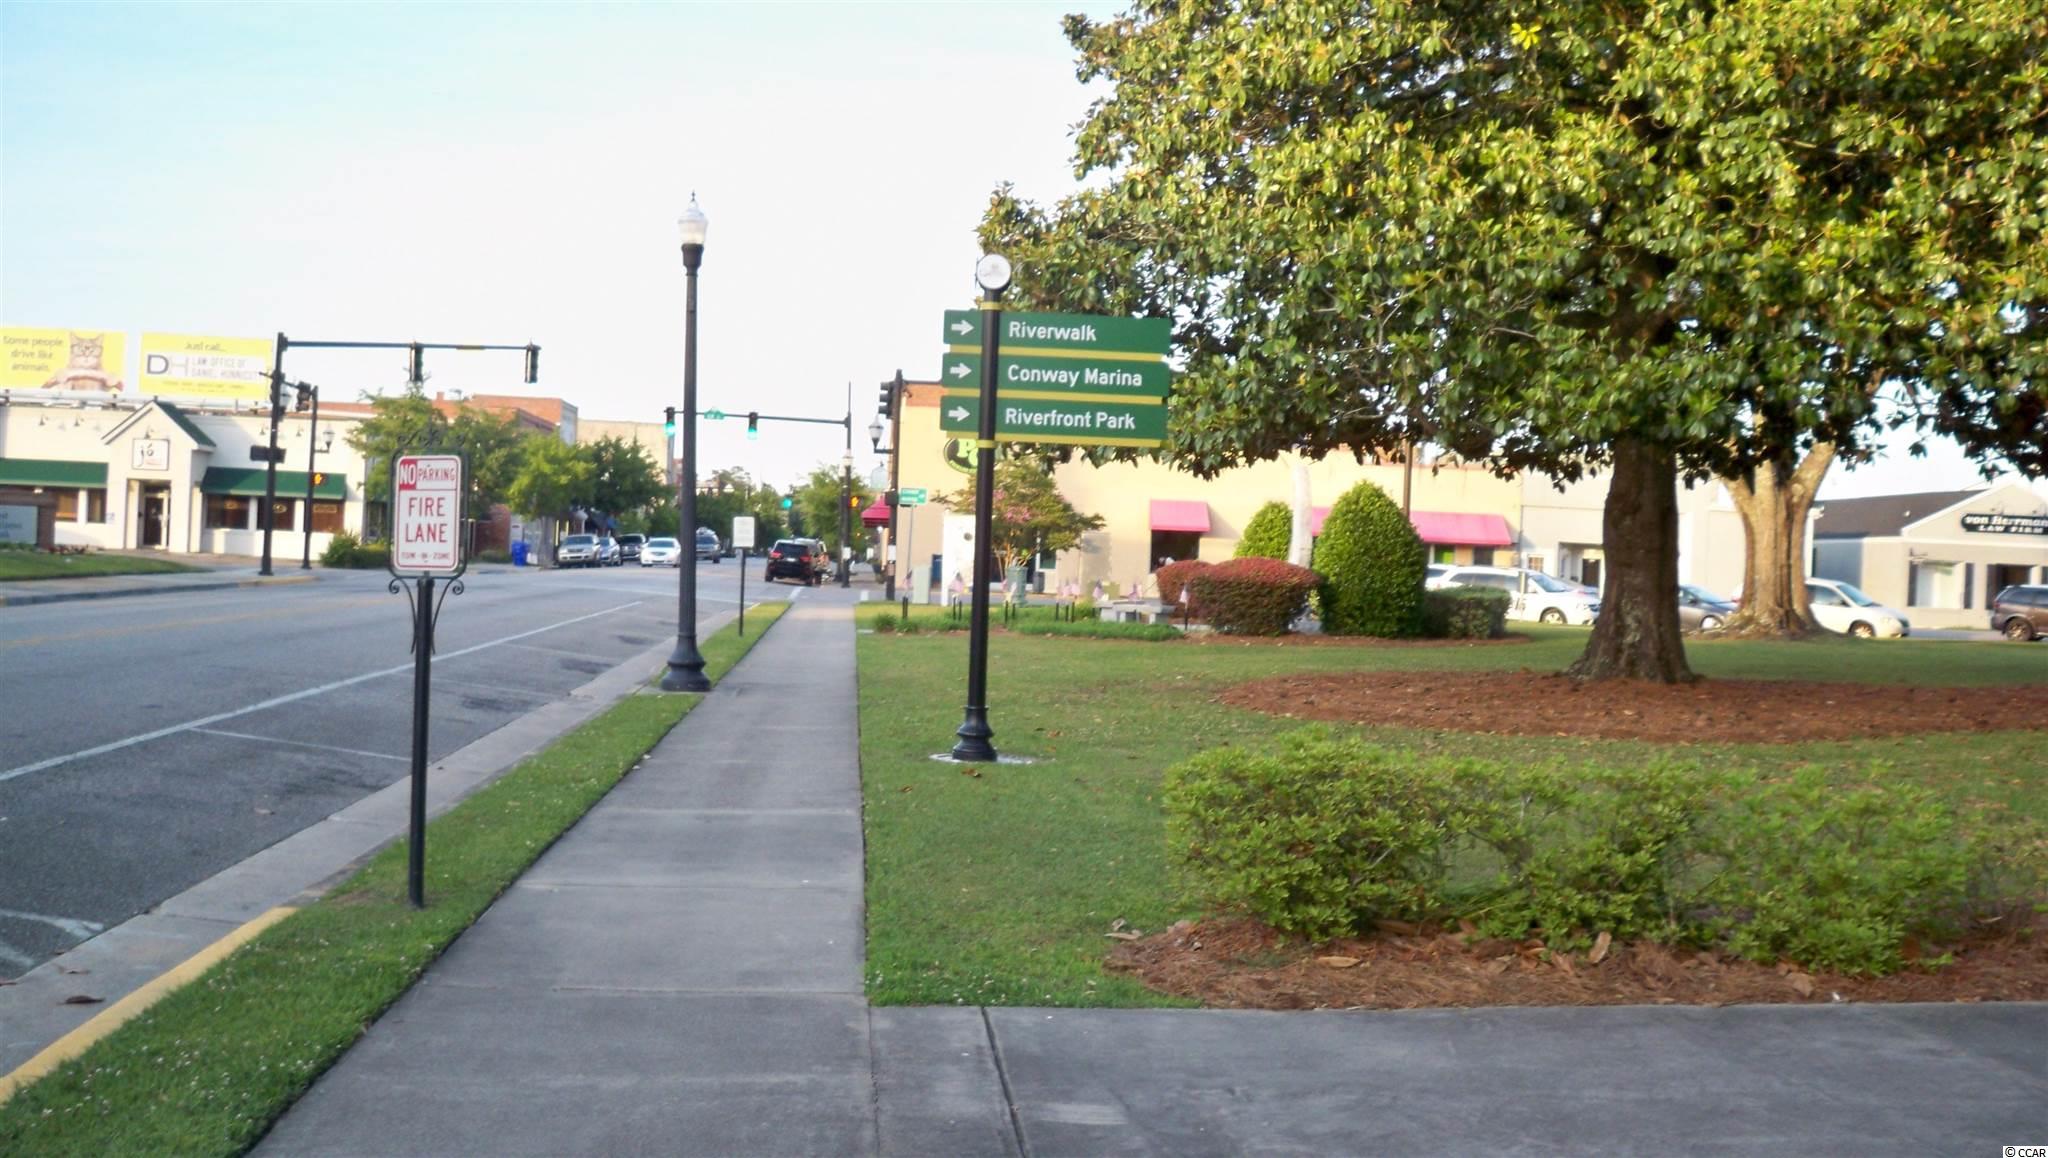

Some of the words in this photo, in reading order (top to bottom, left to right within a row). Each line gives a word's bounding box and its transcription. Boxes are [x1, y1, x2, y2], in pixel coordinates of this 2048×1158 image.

[1008, 320, 1097, 342] Riverwalk
[3, 335, 29, 345] Some
[31, 337, 64, 349] people
[11, 348, 35, 358] drive
[37, 350, 54, 359] like
[1007, 364, 1080, 388] Conway
[1084, 367, 1143, 387] Marina
[1004, 407, 1092, 428] Riverfront
[1095, 410, 1136, 430] Park
[400, 463, 416, 485] NO
[417, 467, 456, 481] PARKING
[408, 497, 446, 517] FIRE
[405, 523, 448, 543] LANE
